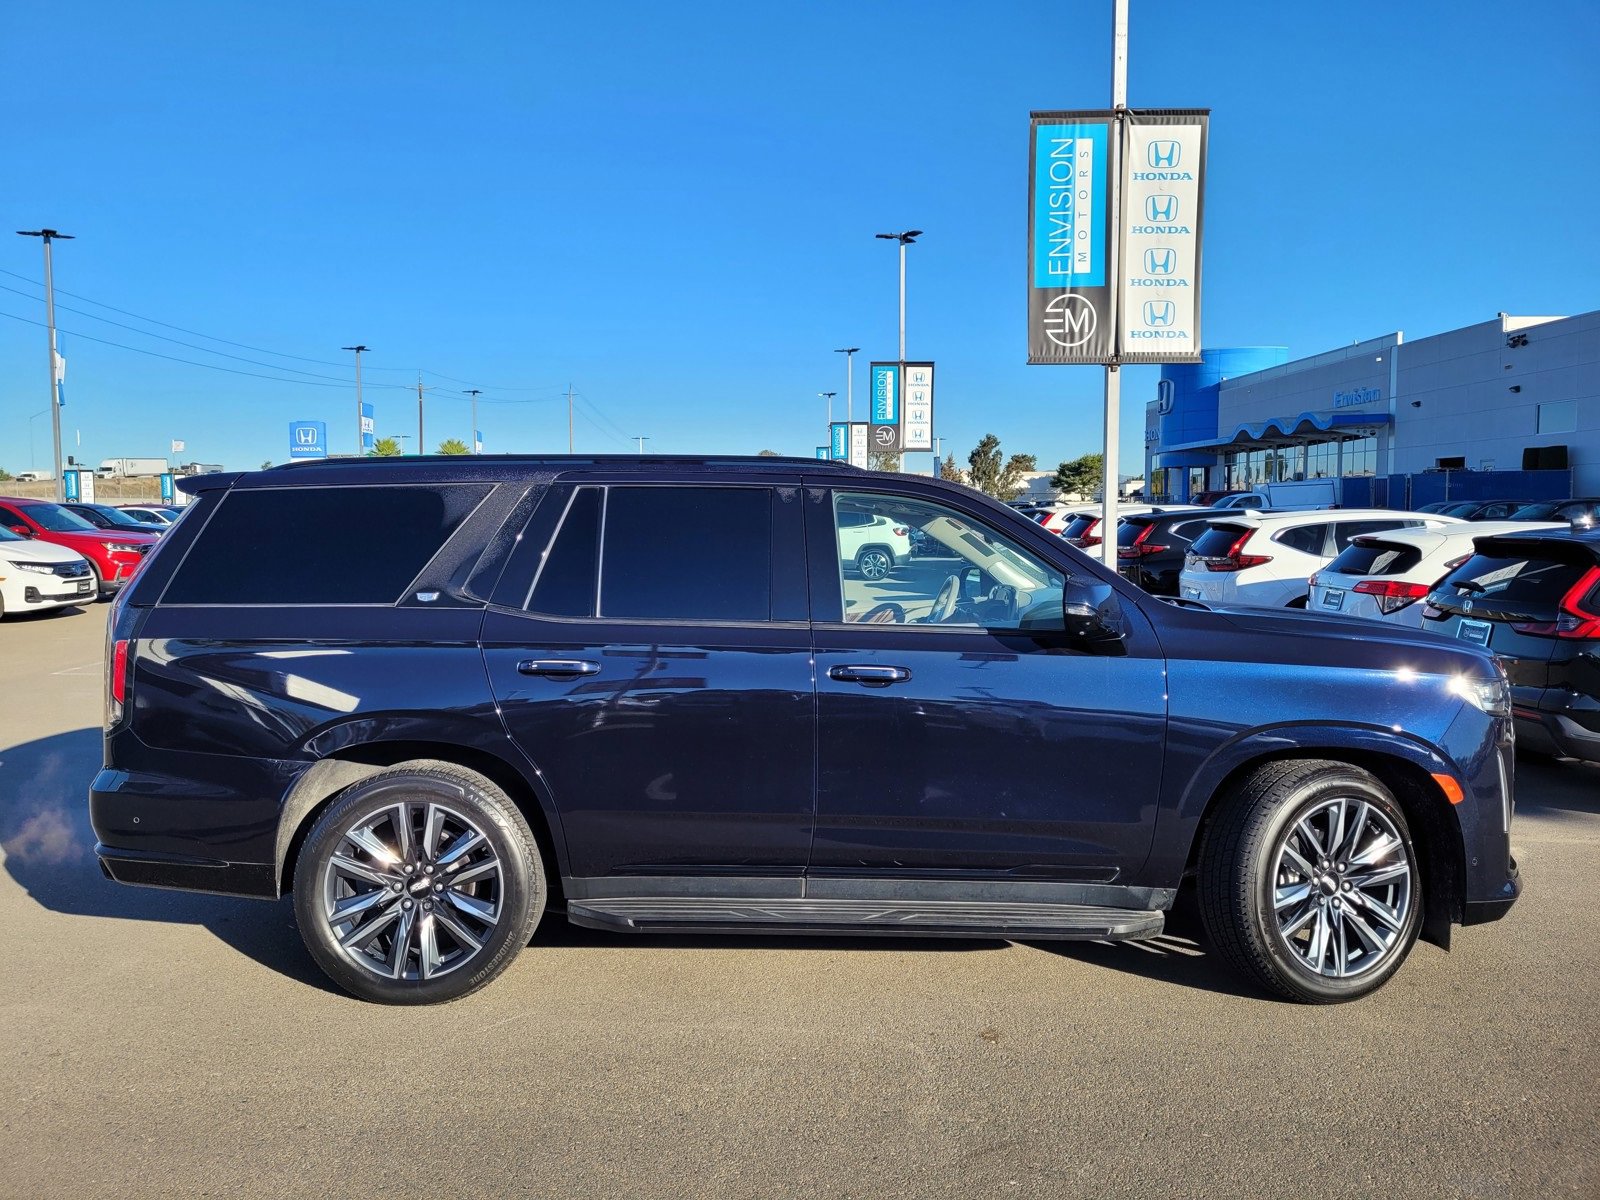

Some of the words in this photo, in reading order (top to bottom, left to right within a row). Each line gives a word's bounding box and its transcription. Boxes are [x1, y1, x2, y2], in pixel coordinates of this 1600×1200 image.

[1133, 172, 1193, 181] HONDA
[1048, 138, 1074, 275] ENVISION
[1078, 150, 1089, 262] MOTORS
[1131, 225, 1190, 234] HONDA
[1130, 278, 1189, 287] HONDA
[1130, 330, 1189, 339] HONDA
[877, 370, 887, 420] ENVISION
[1333, 387, 1380, 408] Envision
[469, 931, 517, 986] BRIDGESTONE
